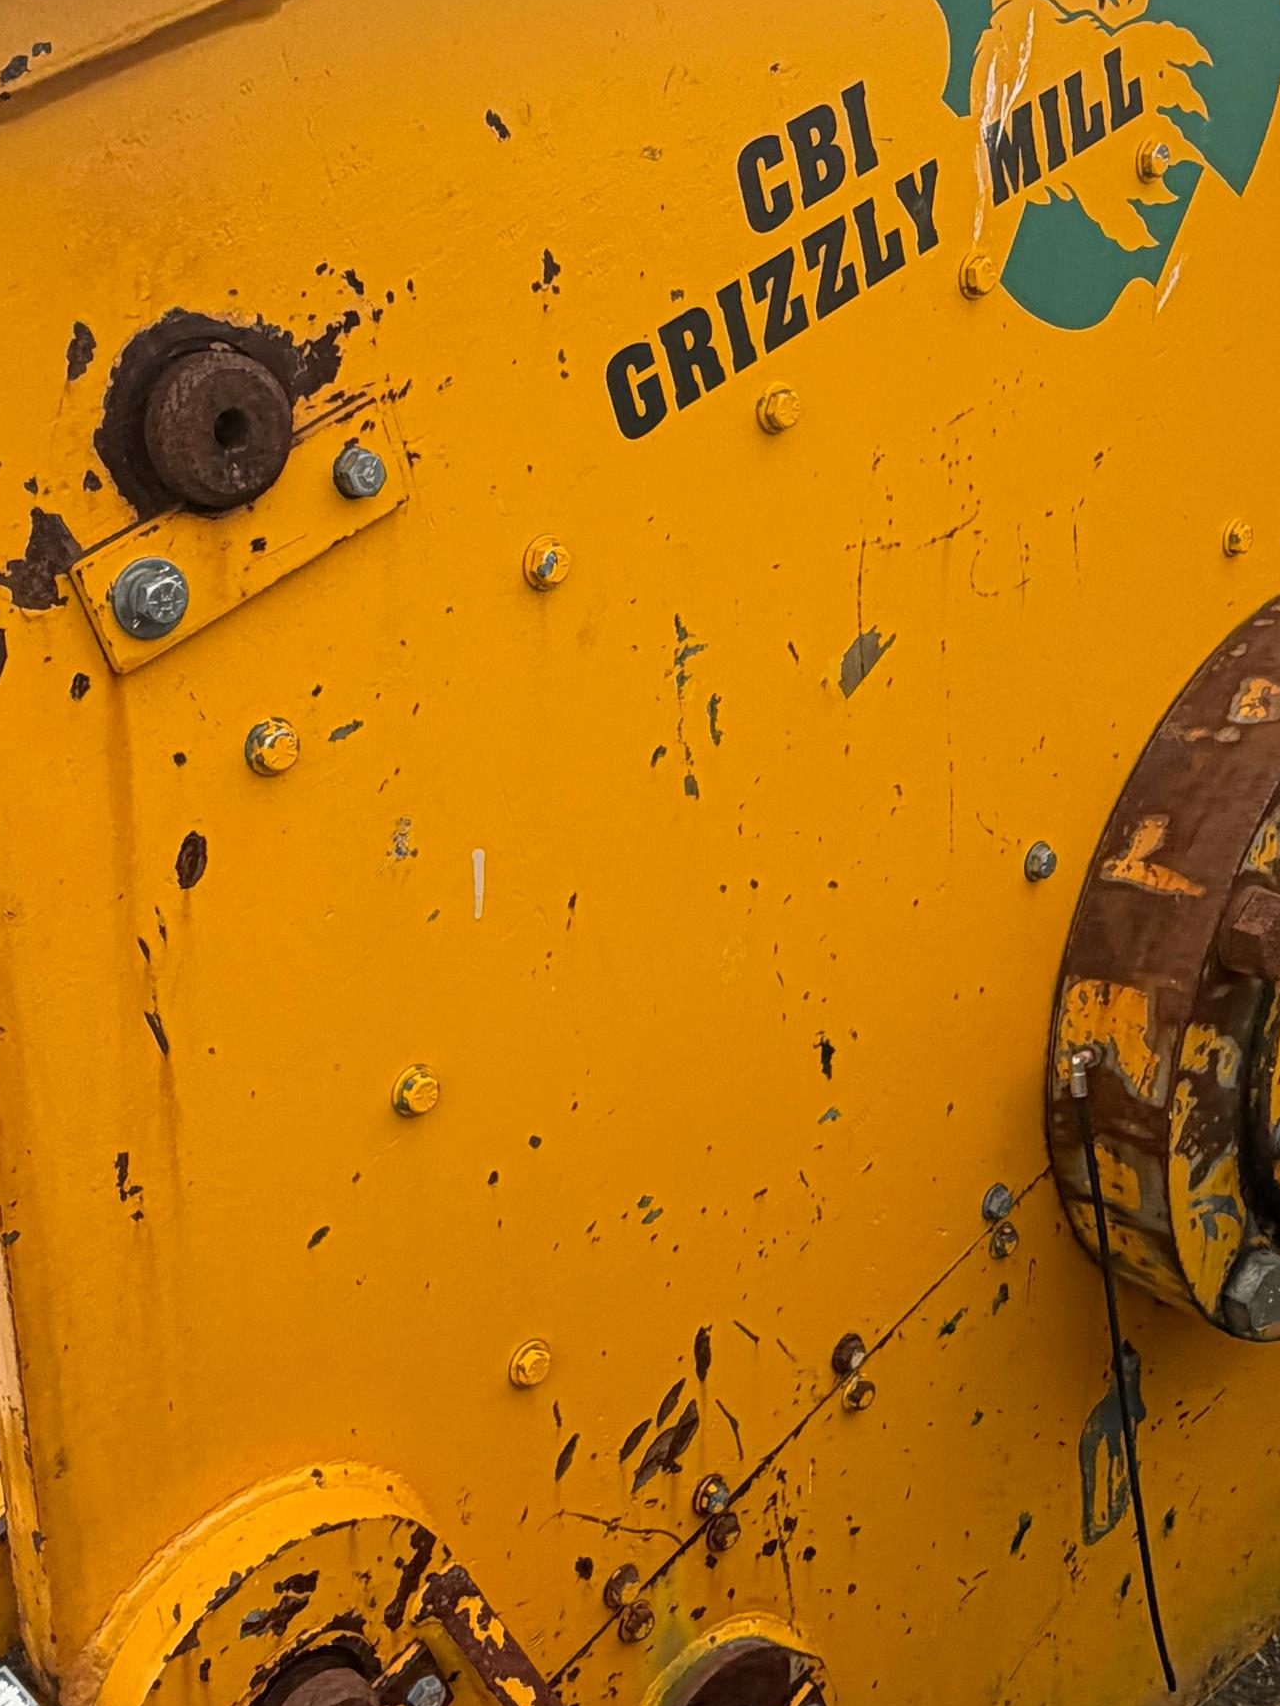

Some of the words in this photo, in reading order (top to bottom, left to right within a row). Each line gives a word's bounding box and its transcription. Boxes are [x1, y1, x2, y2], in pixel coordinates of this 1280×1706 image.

[605, 158, 939, 441] GRIZZLY
[985, 47, 1144, 207] MILL
[736, 80, 879, 234] CBI
